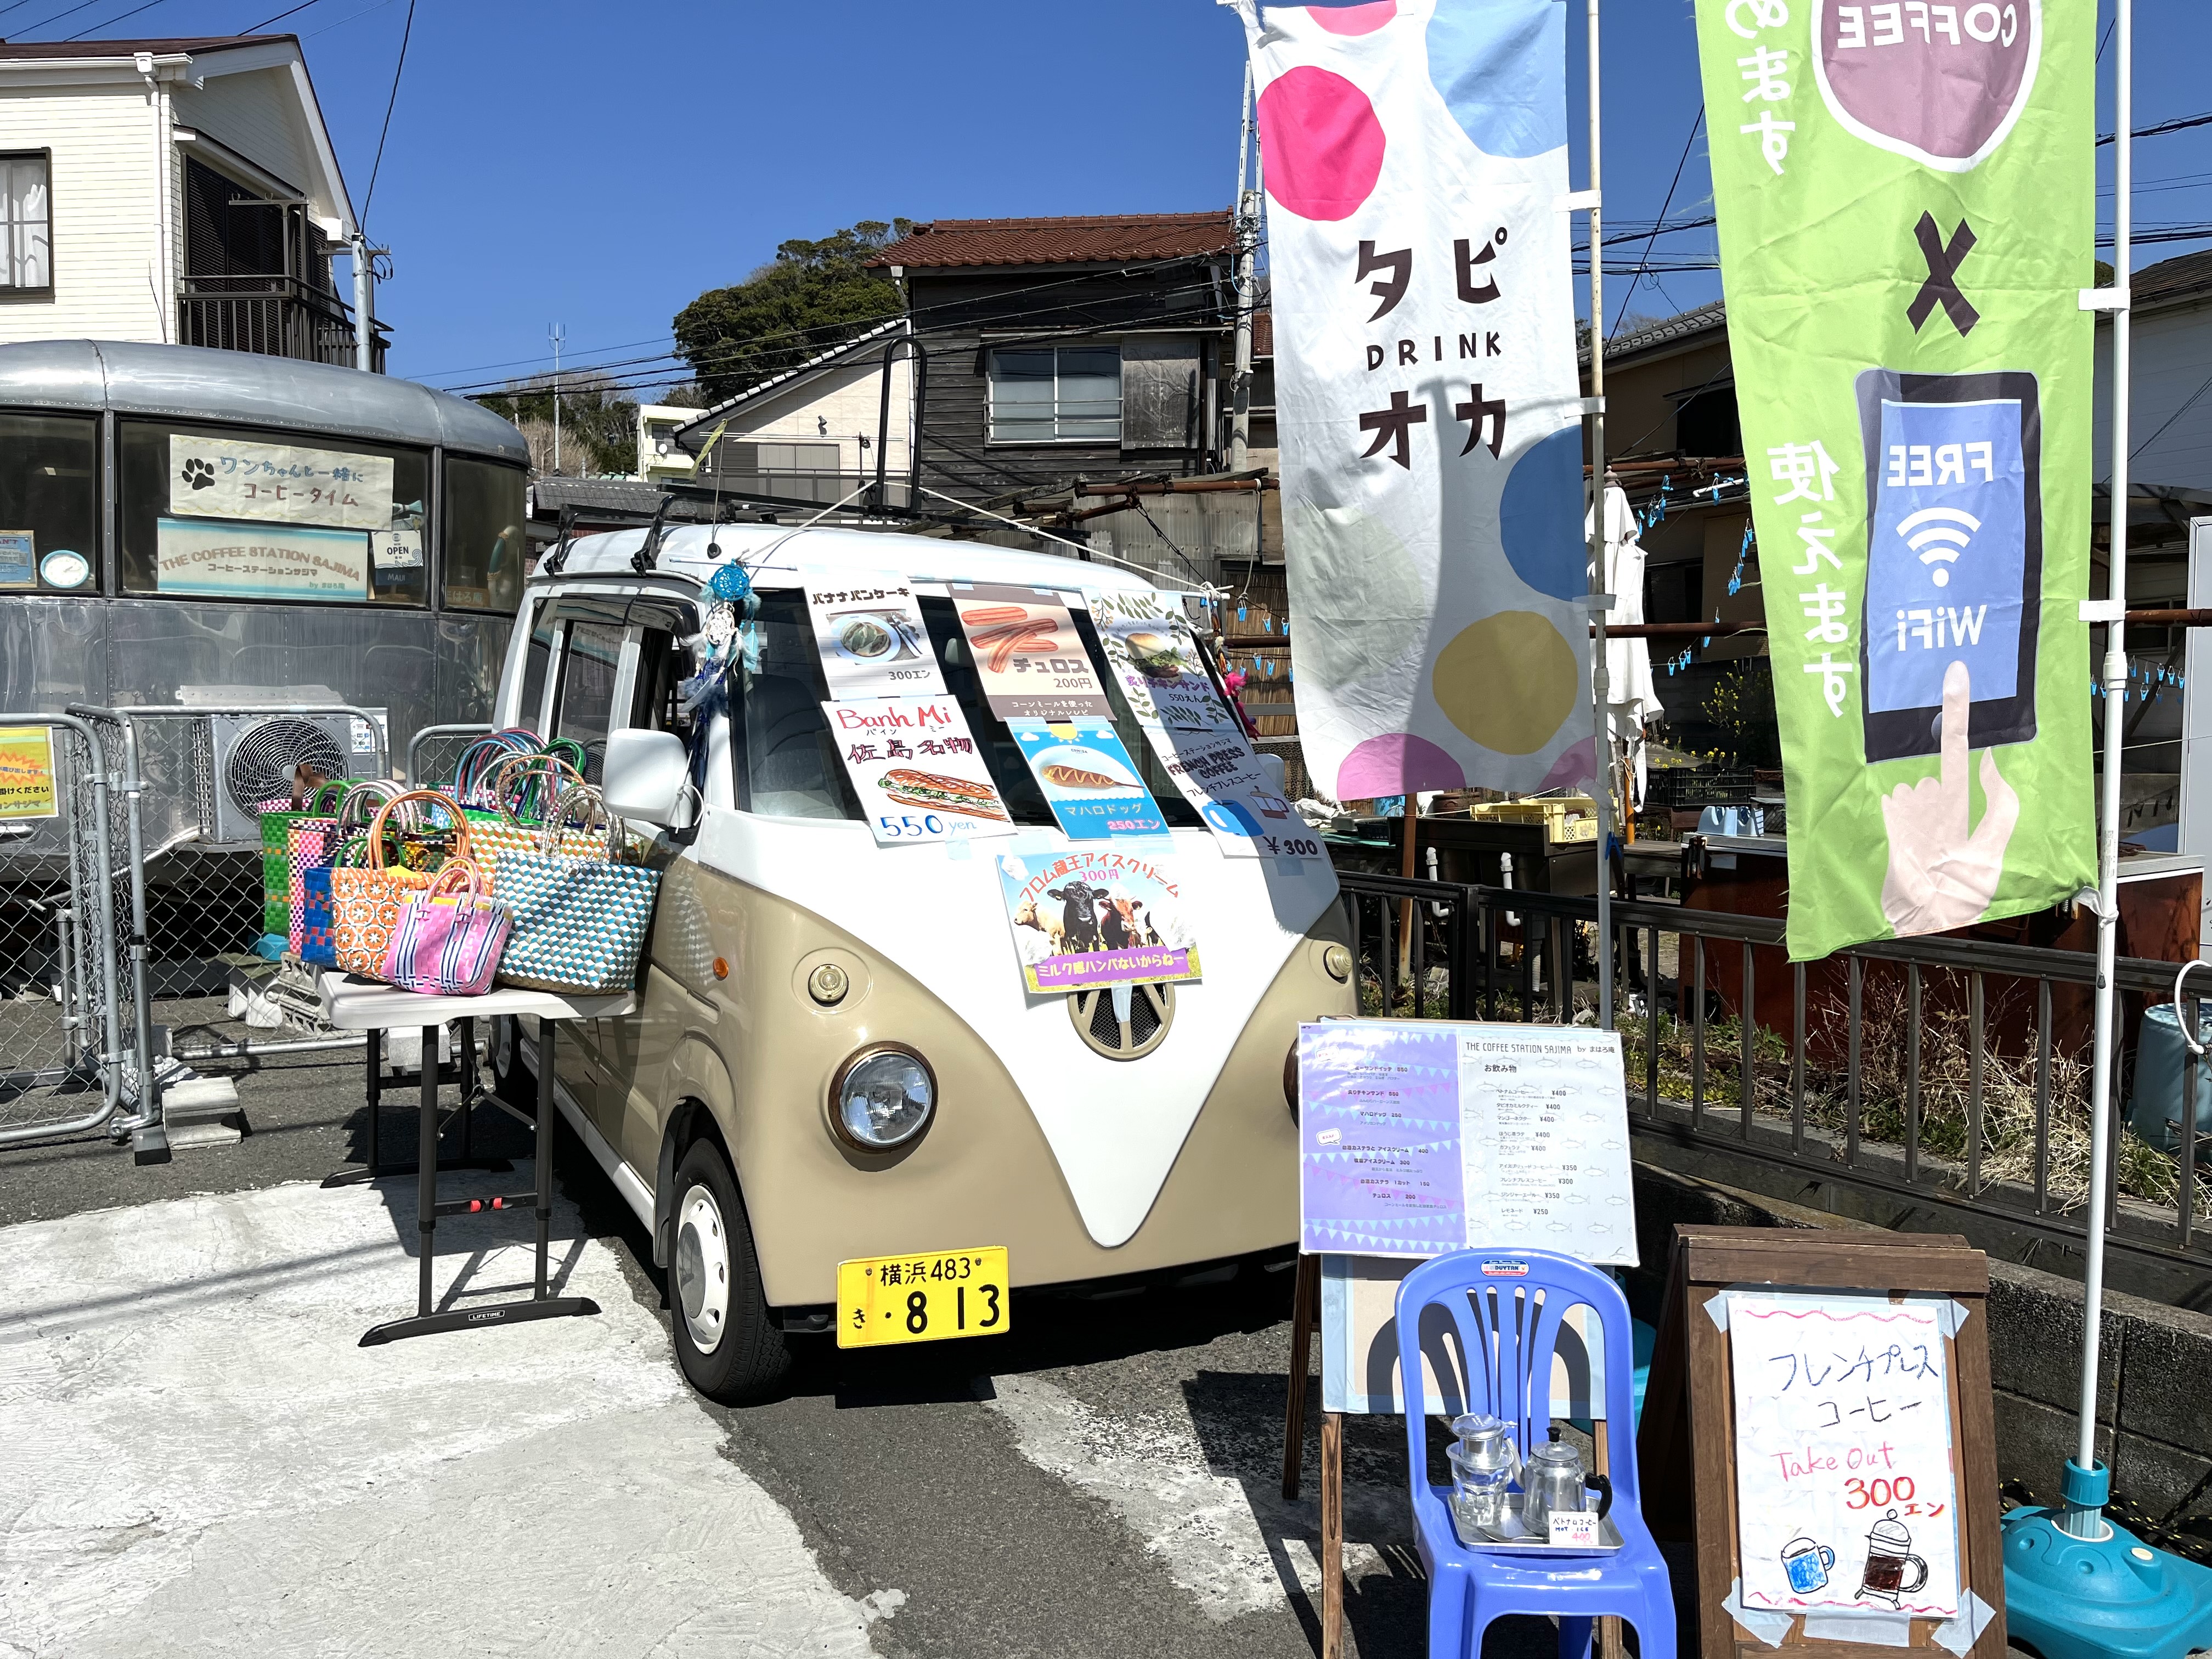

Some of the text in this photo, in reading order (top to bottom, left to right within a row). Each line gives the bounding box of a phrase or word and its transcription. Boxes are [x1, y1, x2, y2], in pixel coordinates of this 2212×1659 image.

[1366, 331, 1503, 371] DRINK
[220, 456, 363, 482] ワンちゃんと一緒に
[244, 483, 359, 506] コーヒータイム
[387, 546, 409, 555] OPEN
[159, 546, 360, 582] THE COFFEE STATION SAJIMA
[207, 563, 318, 577] コーヒーステーションサジマ
[309, 581, 318, 589] by
[387, 573, 405, 582] MAUI
[812, 588, 910, 605] バナナパンケーキ
[1013, 658, 1089, 674] チュロス
[888, 670, 930, 680] 300エン
[1053, 678, 1093, 689] 200円
[1169, 693, 1203, 703] 550えん
[836, 704, 952, 729] Banh Mi
[847, 737, 973, 764] 佐島名物
[1161, 738, 1232, 761] コーヒーステーションサジマ
[1166, 746, 1245, 776] FRENCH PRESS
[1198, 761, 1239, 778] COFFEE
[1065, 803, 1142, 815] マハロドッグ
[880, 814, 977, 837] 550 yen
[1106, 819, 1161, 831] 250エン
[1019, 853, 1179, 902] フロム蔵王アイスクリーム
[1081, 868, 1120, 882] 300円
[1466, 1042, 1480, 1051] THE
[1483, 1043, 1509, 1052] COFFEE
[1511, 1044, 1542, 1053] STATION
[1544, 1045, 1572, 1054] SAJIMA
[1484, 1064, 1517, 1073] お飲み物
[472, 1312, 501, 1320] LIFETIME
[852, 1308, 866, 1329] き
[1768, 1344, 1939, 1391] フレンチプレス
[1818, 1396, 1922, 1428] コーヒー
[1770, 1440, 1895, 1482] Take Out
[1844, 1476, 1916, 1510] 300
[1904, 1502, 1945, 1517] エン
[1553, 1517, 1596, 1526] ベトナムコーヒー
[1572, 1532, 1591, 1542] 400
